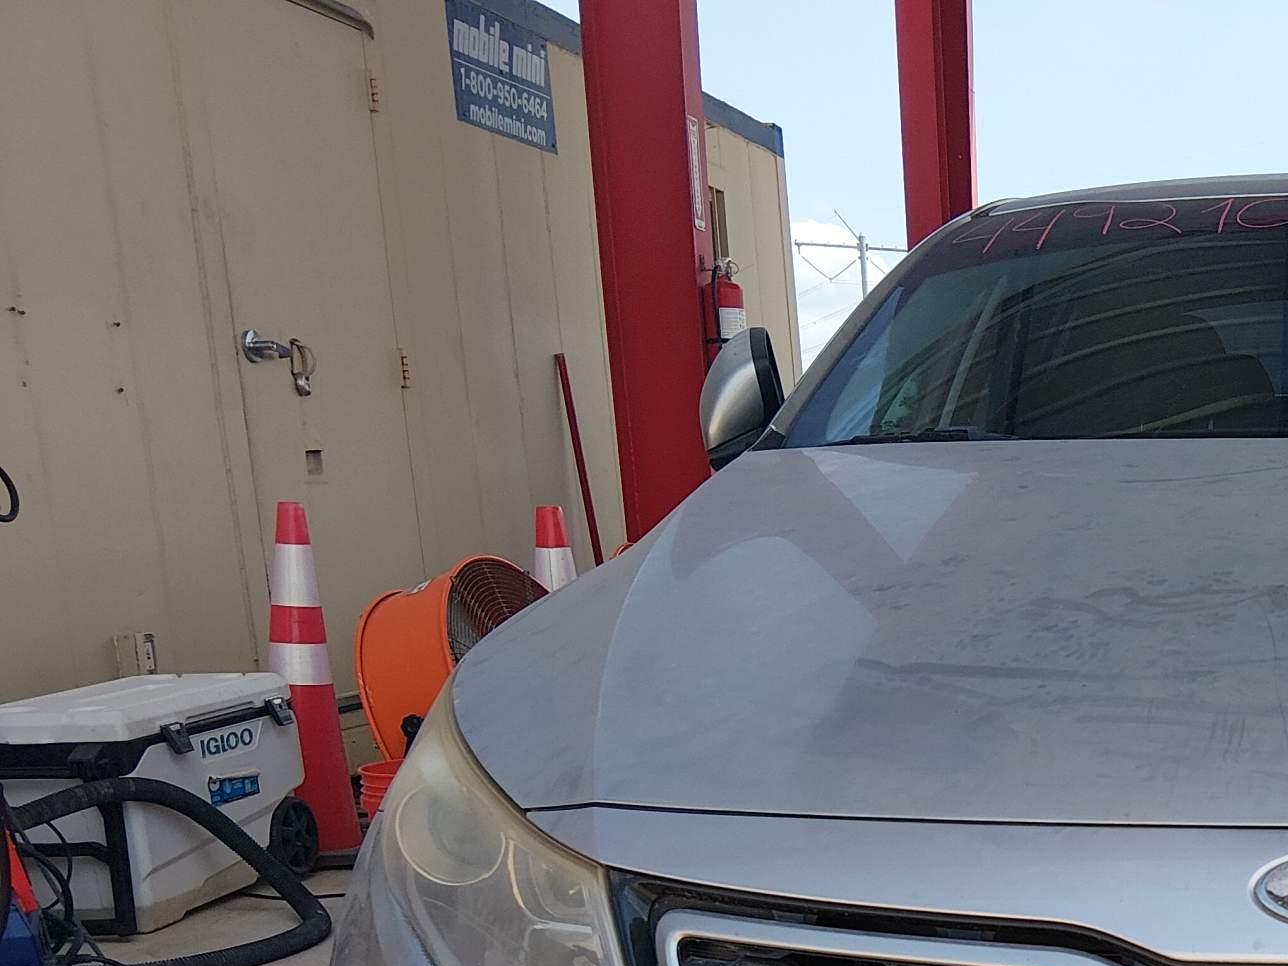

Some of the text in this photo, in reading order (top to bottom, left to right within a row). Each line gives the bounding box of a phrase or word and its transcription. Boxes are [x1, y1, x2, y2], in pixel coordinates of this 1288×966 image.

[453, 14, 545, 87] mobile mini
[460, 67, 548, 120] 1-800-950-6464
[470, 104, 546, 146] mobilemini.com
[200, 728, 253, 758] IGLOO
